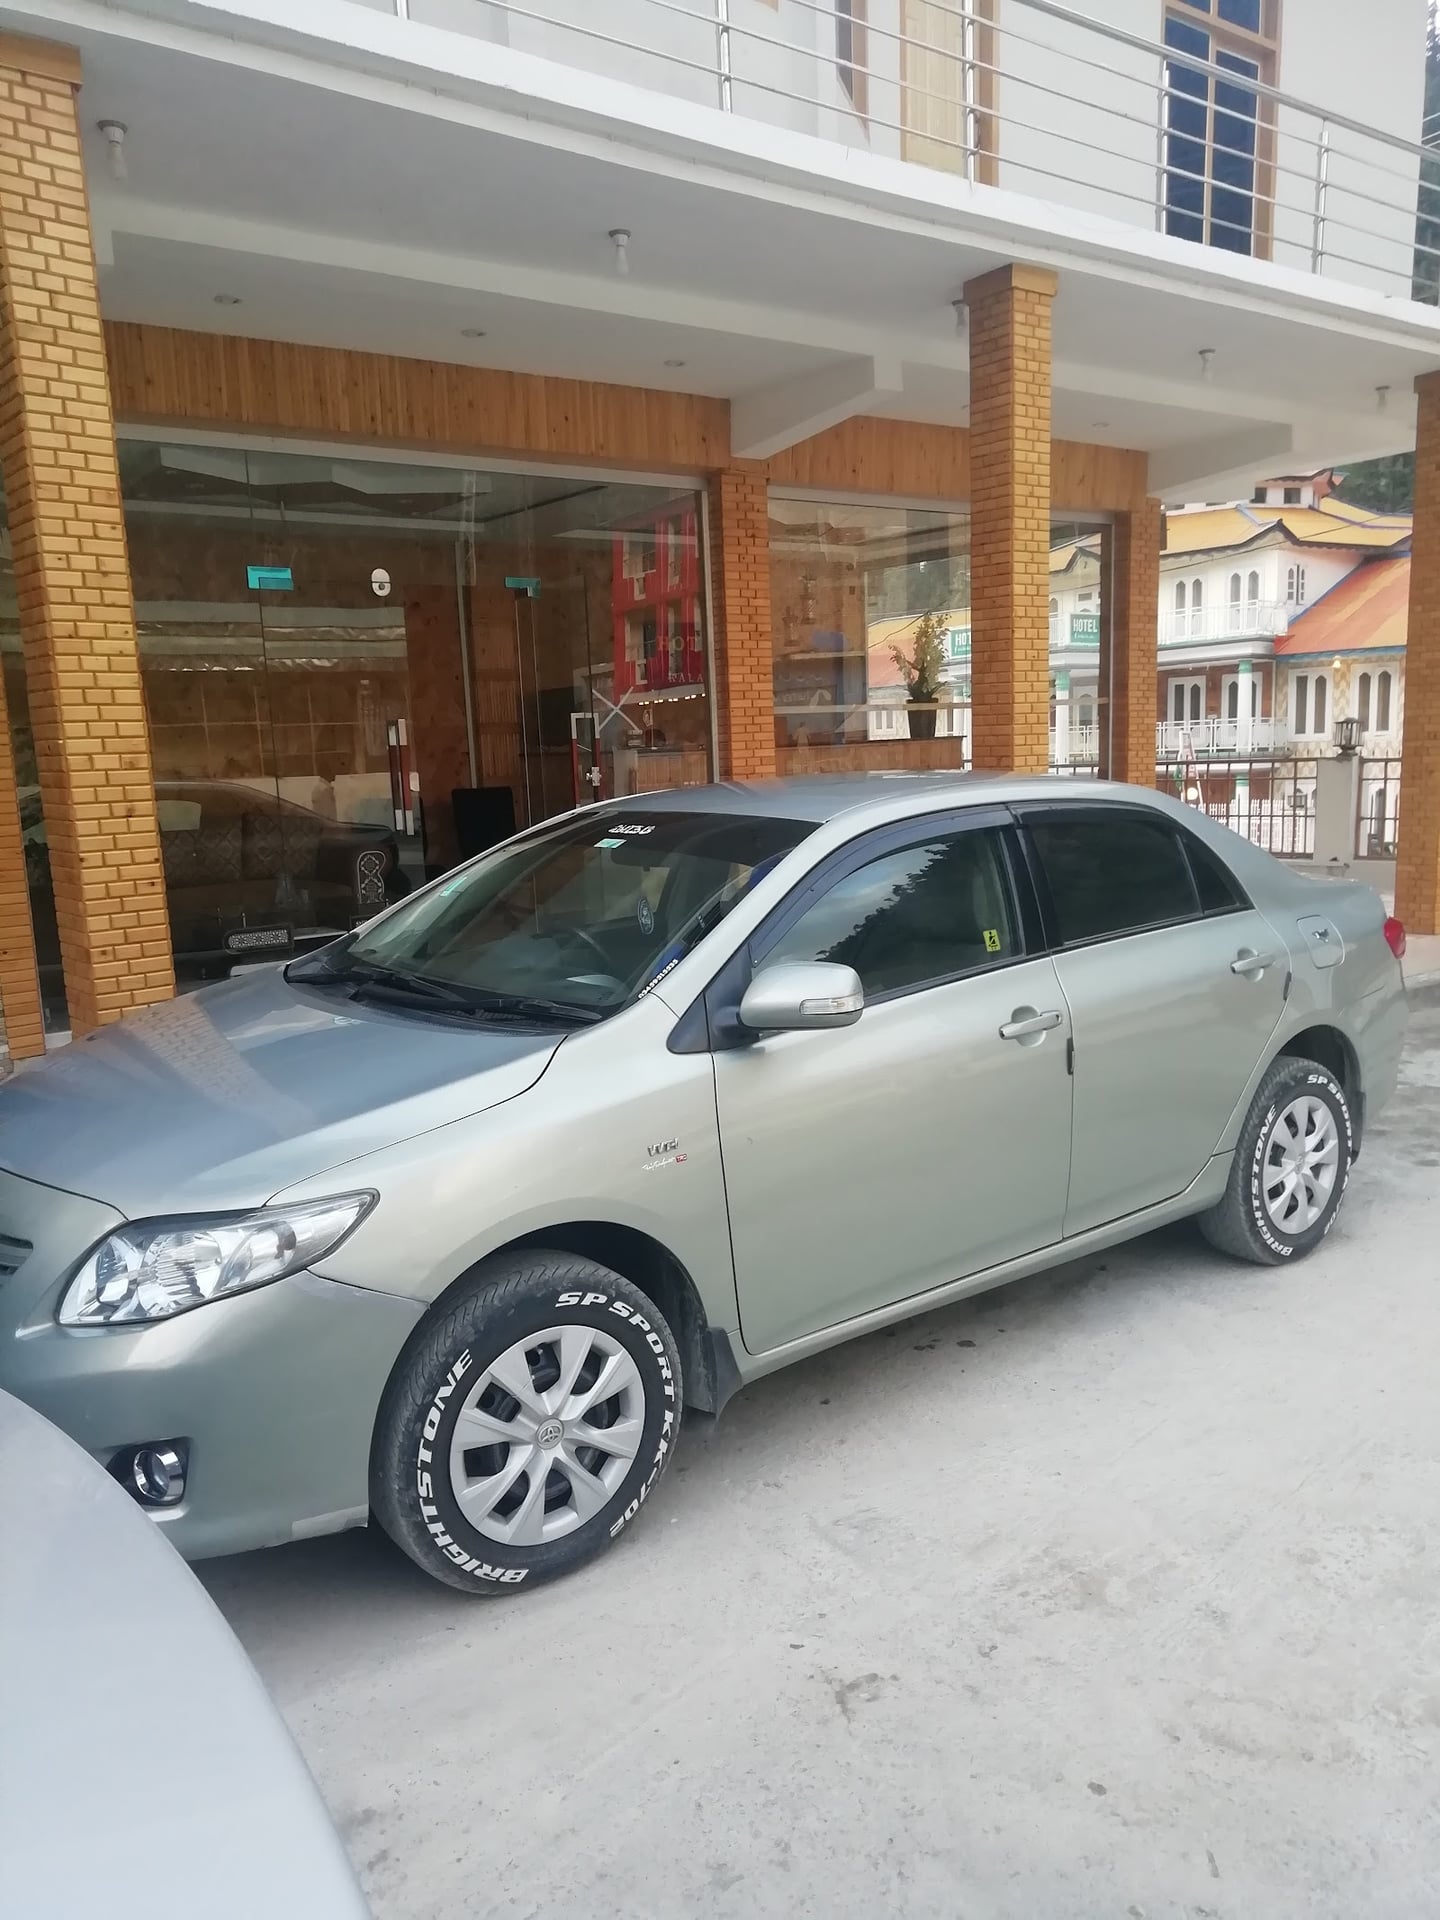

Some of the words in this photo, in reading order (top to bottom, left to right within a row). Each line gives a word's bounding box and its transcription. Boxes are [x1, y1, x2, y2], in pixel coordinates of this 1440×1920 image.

[1073, 619, 1098, 632] HOTEL
[1307, 1074, 1328, 1084] SP
[1251, 1104, 1294, 1257] BRIGHTSTONE
[555, 1292, 608, 1307] SP
[608, 1301, 675, 1402] SPORT
[417, 1349, 529, 1584] BRIGHTSTONE
[609, 1410, 674, 1538] KK-702
